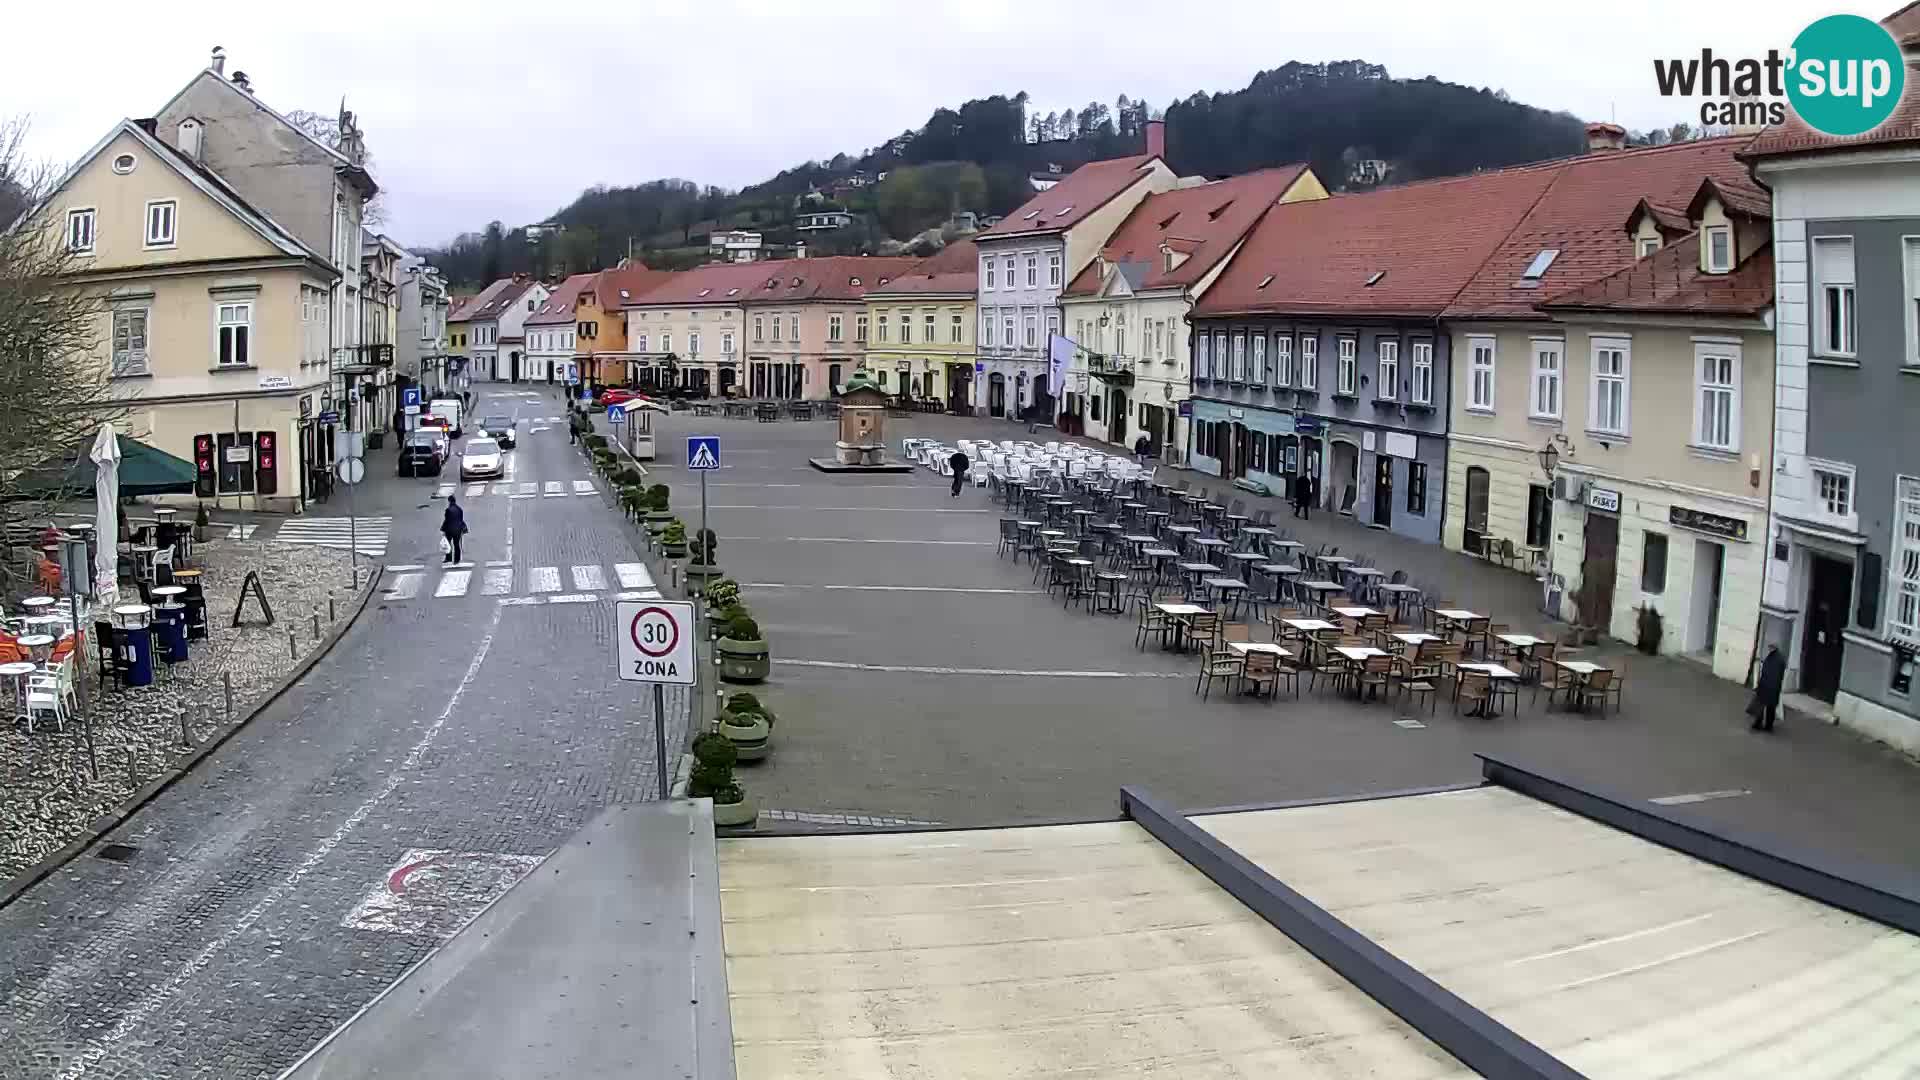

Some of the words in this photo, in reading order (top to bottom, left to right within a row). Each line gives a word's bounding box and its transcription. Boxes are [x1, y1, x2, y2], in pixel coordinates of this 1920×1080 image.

[408, 392, 416, 404] P
[643, 622, 667, 644] 30
[634, 660, 678, 677] ZONA
